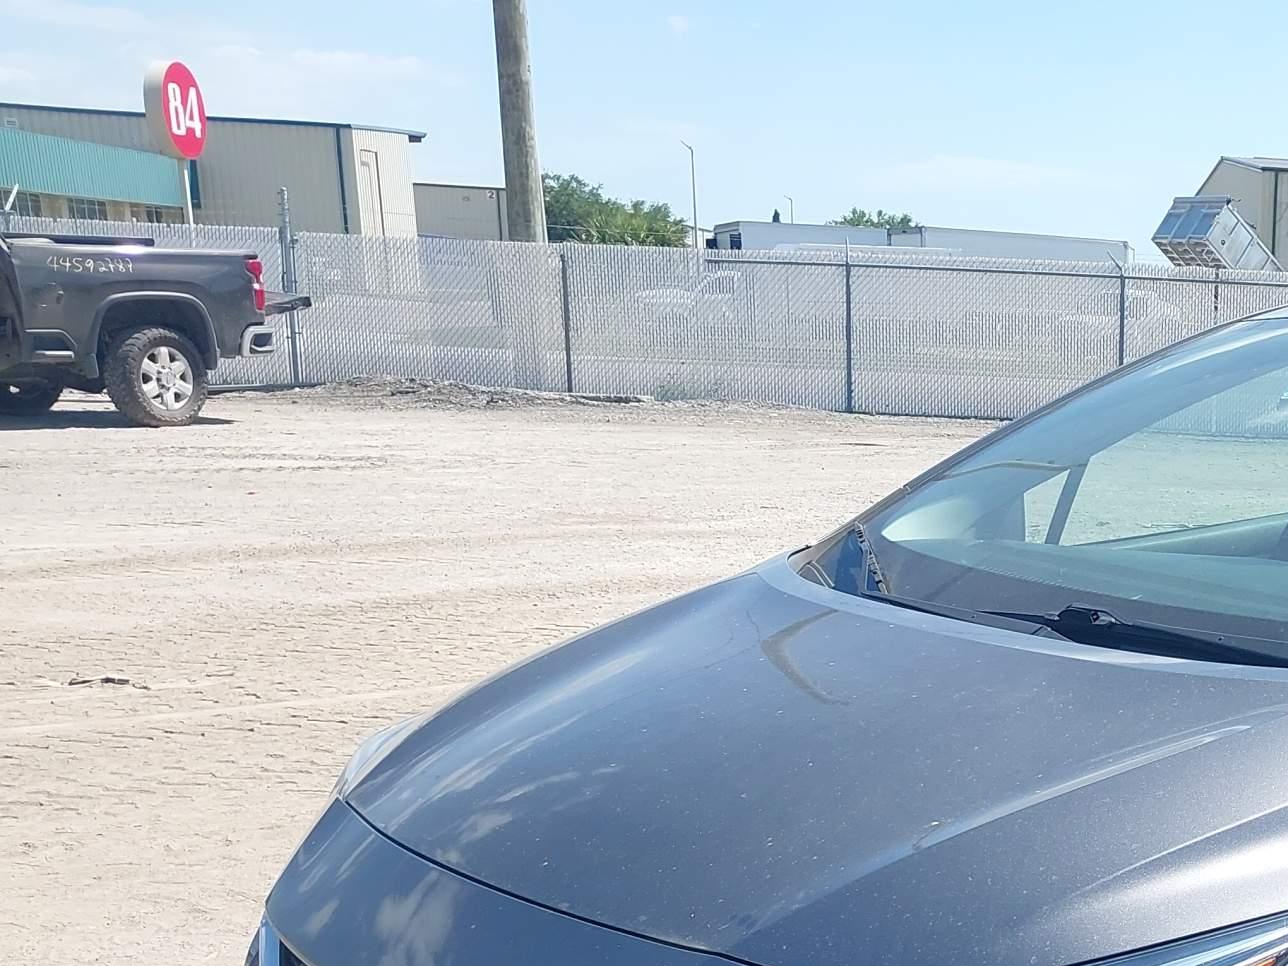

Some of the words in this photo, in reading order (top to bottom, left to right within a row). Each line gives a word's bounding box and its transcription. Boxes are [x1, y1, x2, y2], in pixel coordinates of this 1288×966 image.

[167, 82, 202, 138] 84
[487, 190, 495, 199] 2
[46, 256, 133, 273] 44592787
